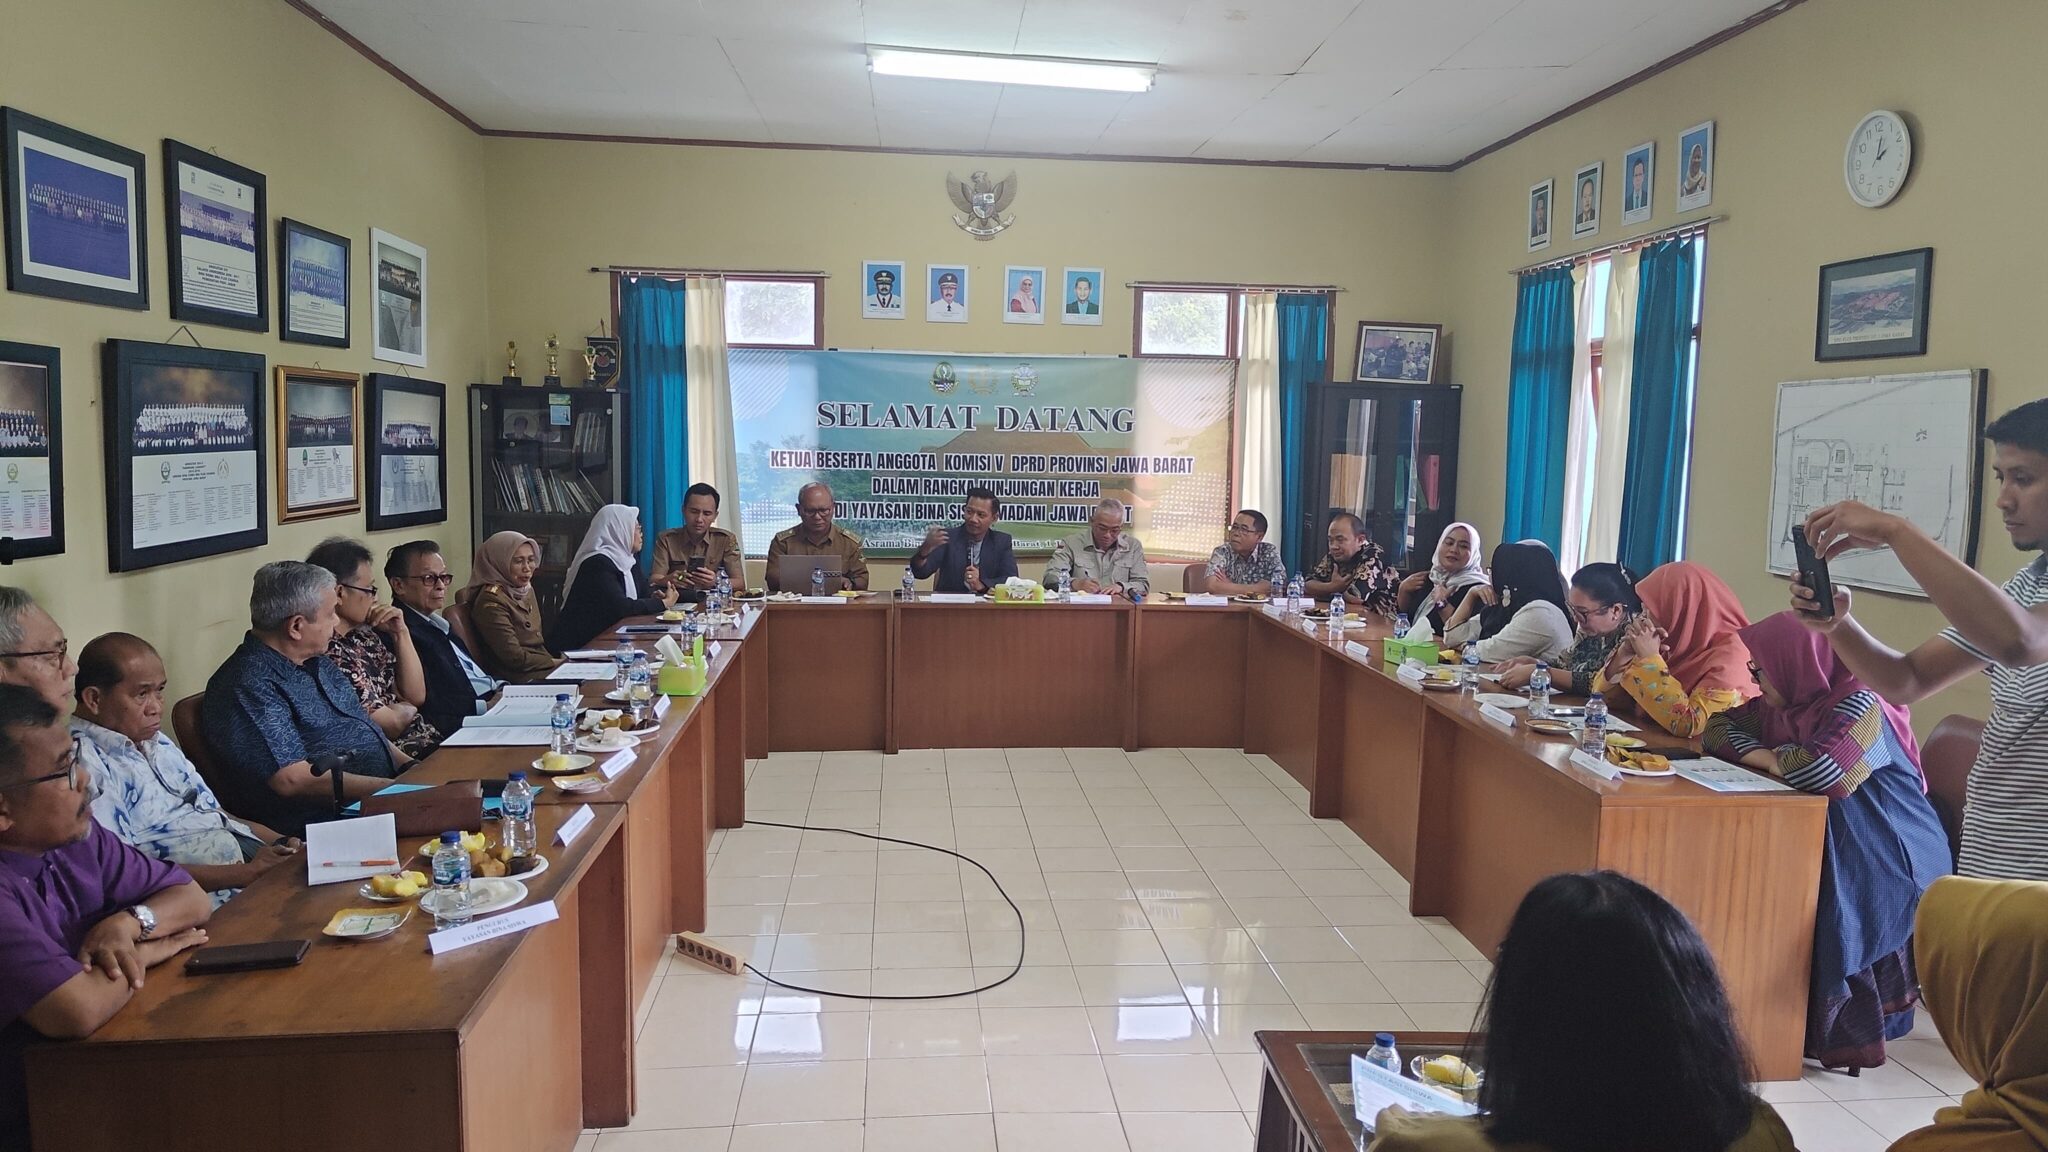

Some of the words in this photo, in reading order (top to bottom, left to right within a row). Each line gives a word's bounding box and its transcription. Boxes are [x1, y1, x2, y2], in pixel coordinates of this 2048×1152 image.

[817, 402, 980, 430] SELAMAT
[995, 405, 1136, 433] DATANG
[770, 449, 812, 469] KETUA
[816, 451, 873, 470] BESERTA
[877, 452, 937, 472] ANGGOTA
[944, 453, 991, 473] KOMISI
[994, 454, 1004, 473] V
[1011, 454, 1046, 474] DPRD
[1049, 455, 1108, 474] PROVINSI
[1111, 456, 1149, 475] JAWA
[1152, 456, 1194, 475] BARAT
[872, 476, 920, 496] DALAM
[923, 478, 975, 497] RANGKA
[1059, 480, 1100, 498] KERJA
[833, 501, 848, 520] DI
[851, 502, 911, 520] YAYASAN
[915, 503, 946, 521] BINA
[998, 504, 1046, 522] MADANI
[1050, 505, 1088, 522] JAWA
[861, 538, 900, 549] Asrama
